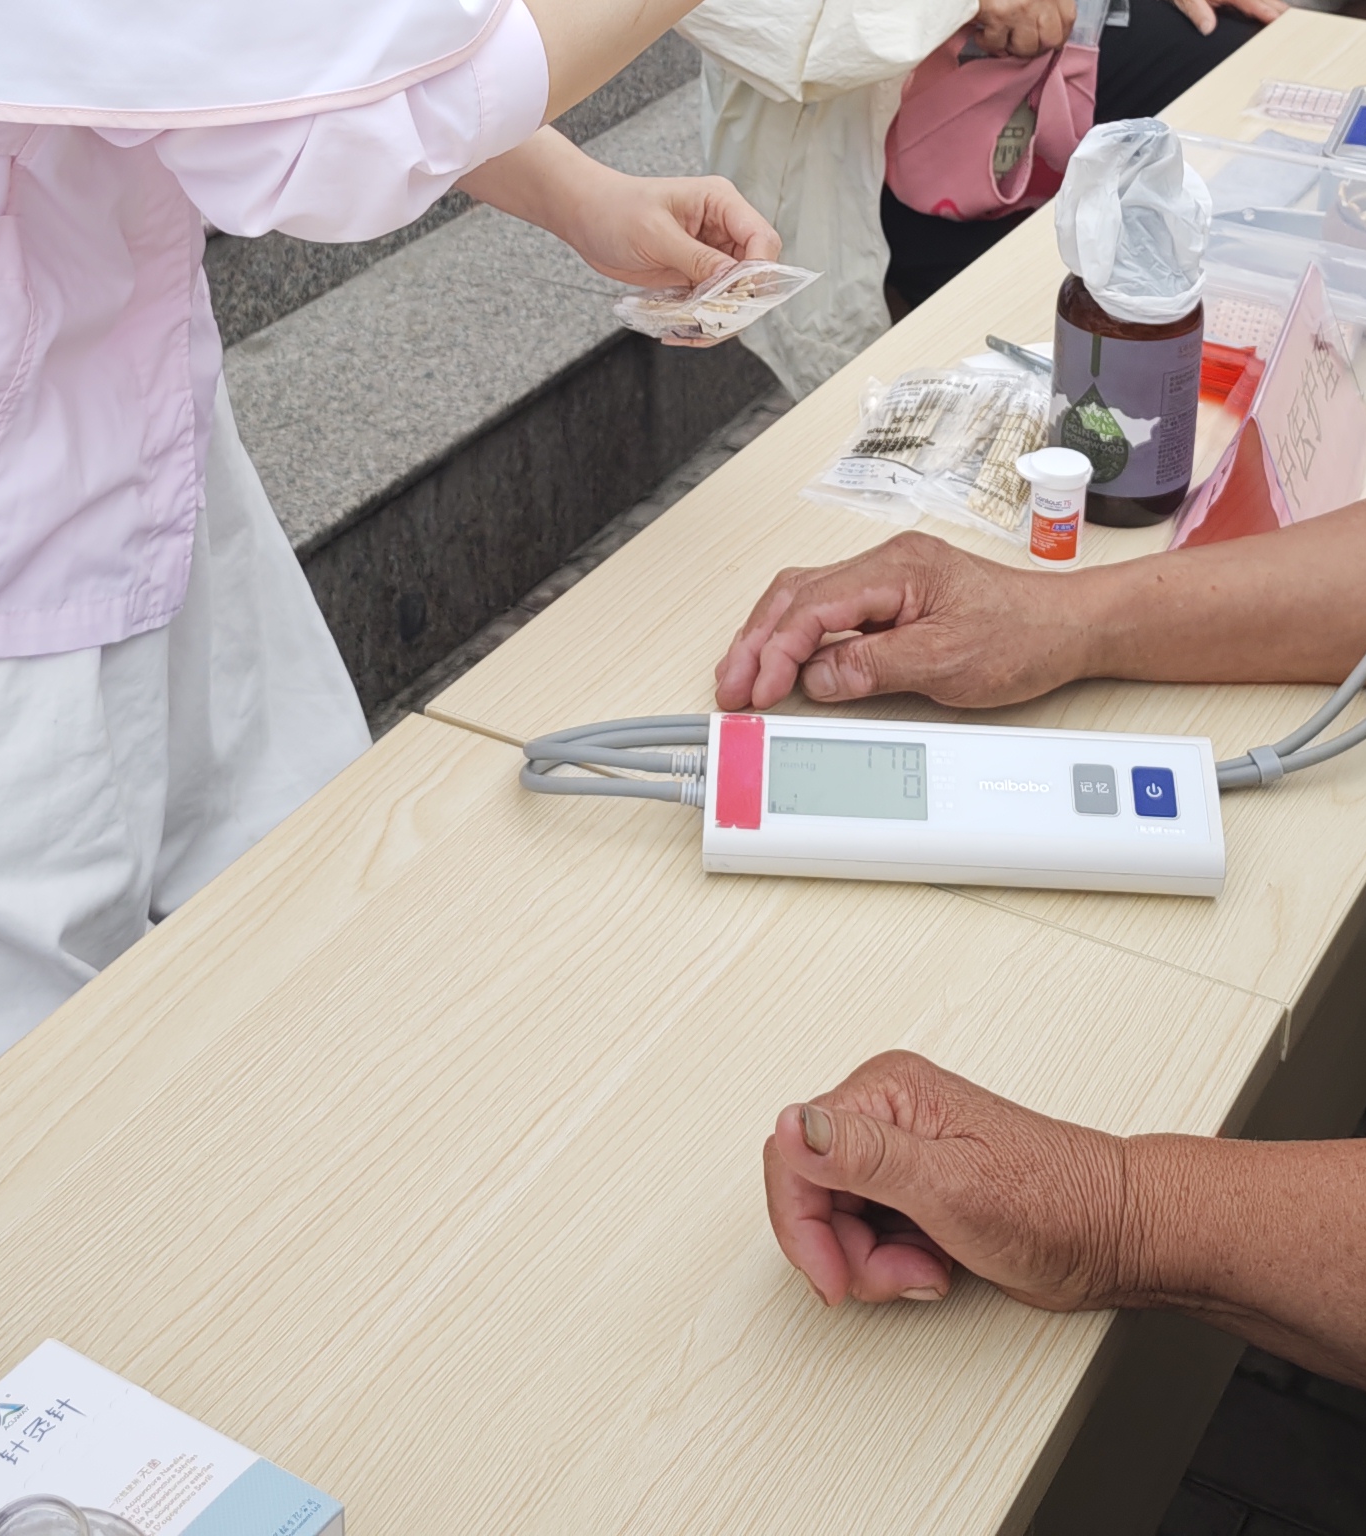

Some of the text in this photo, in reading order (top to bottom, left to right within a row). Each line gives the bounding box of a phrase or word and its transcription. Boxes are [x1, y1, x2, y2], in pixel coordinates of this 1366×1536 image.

[867, 746, 921, 771] 170
[903, 774, 921, 799] 0
[1080, 781, 1110, 794] 记忆
[137, 1458, 162, 1479] 无菌
